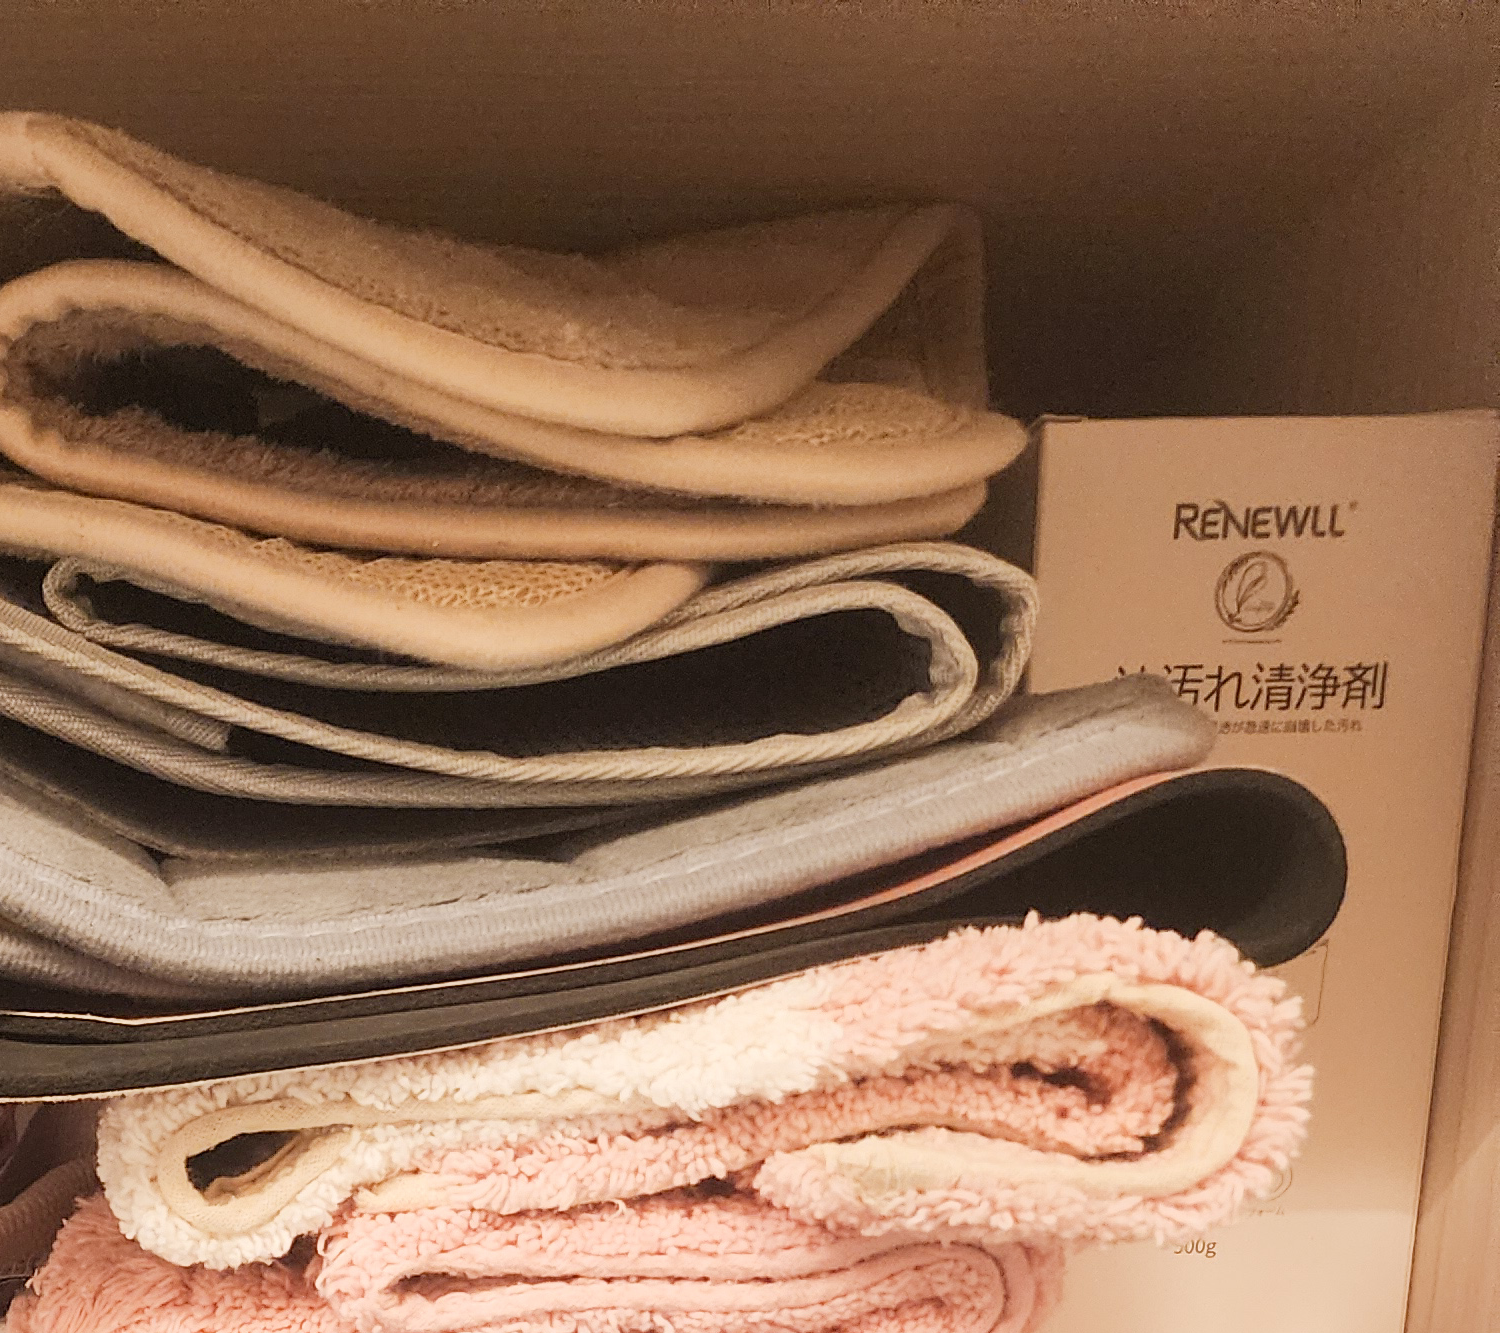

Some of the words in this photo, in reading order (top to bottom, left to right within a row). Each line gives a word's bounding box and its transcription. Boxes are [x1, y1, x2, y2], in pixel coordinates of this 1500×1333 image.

[1117, 660, 1389, 712] 汚れ清浄剤
